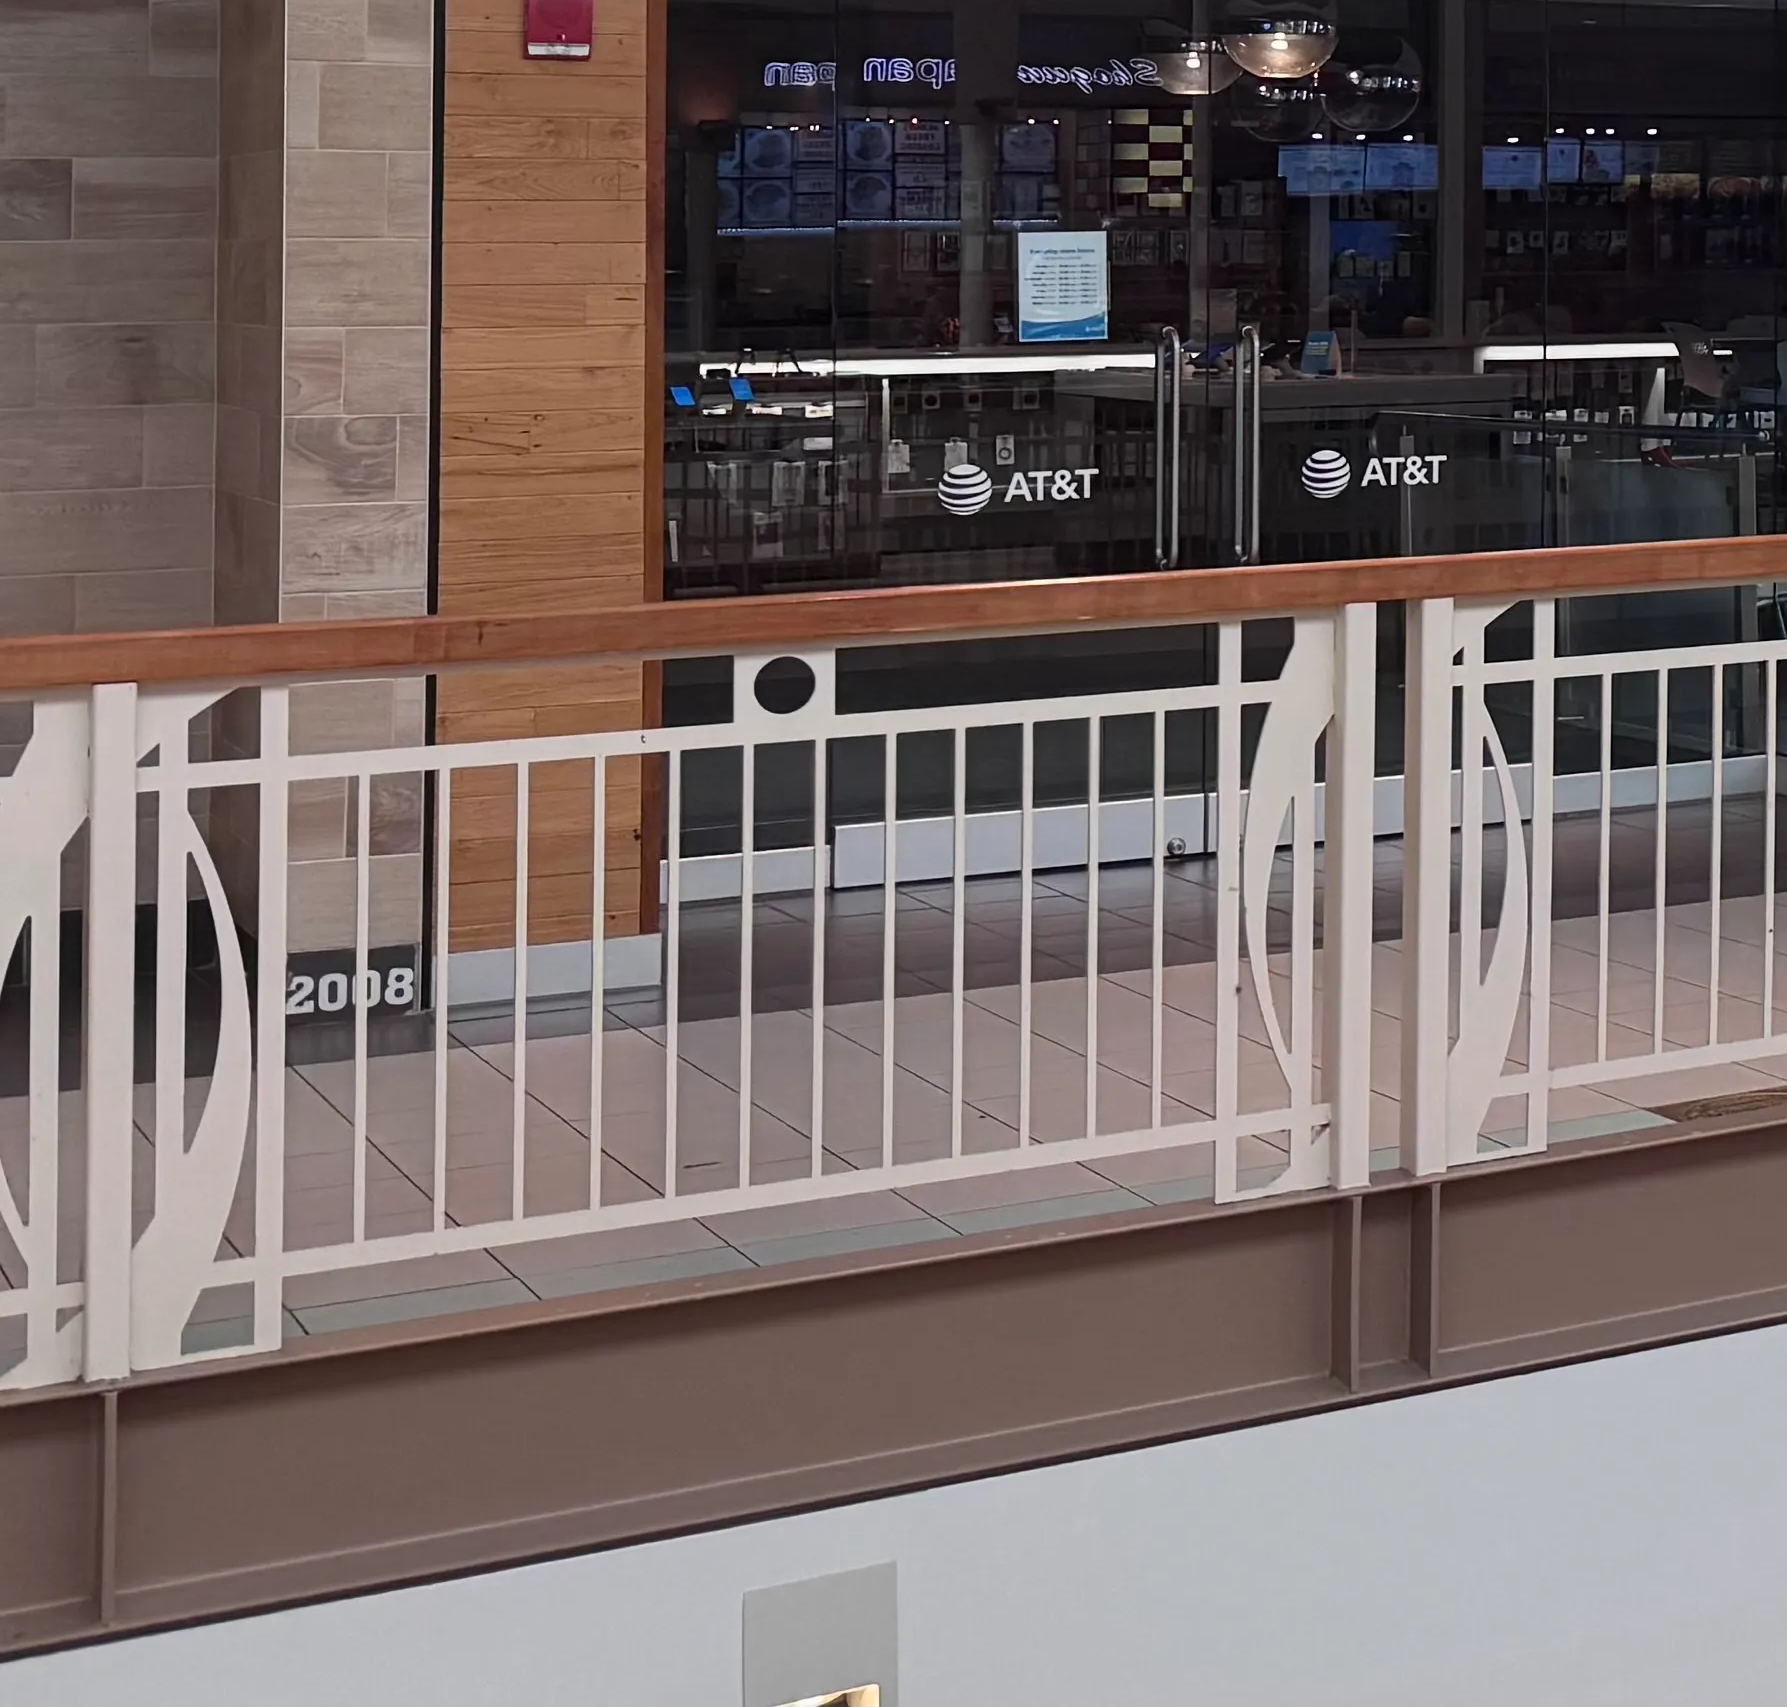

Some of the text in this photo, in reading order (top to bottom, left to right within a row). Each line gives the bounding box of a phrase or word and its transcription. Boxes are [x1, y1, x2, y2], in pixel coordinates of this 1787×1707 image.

[1003, 468, 1100, 503] AT&T
[1361, 455, 1447, 487] AT&T
[285, 967, 413, 1014] 2008
